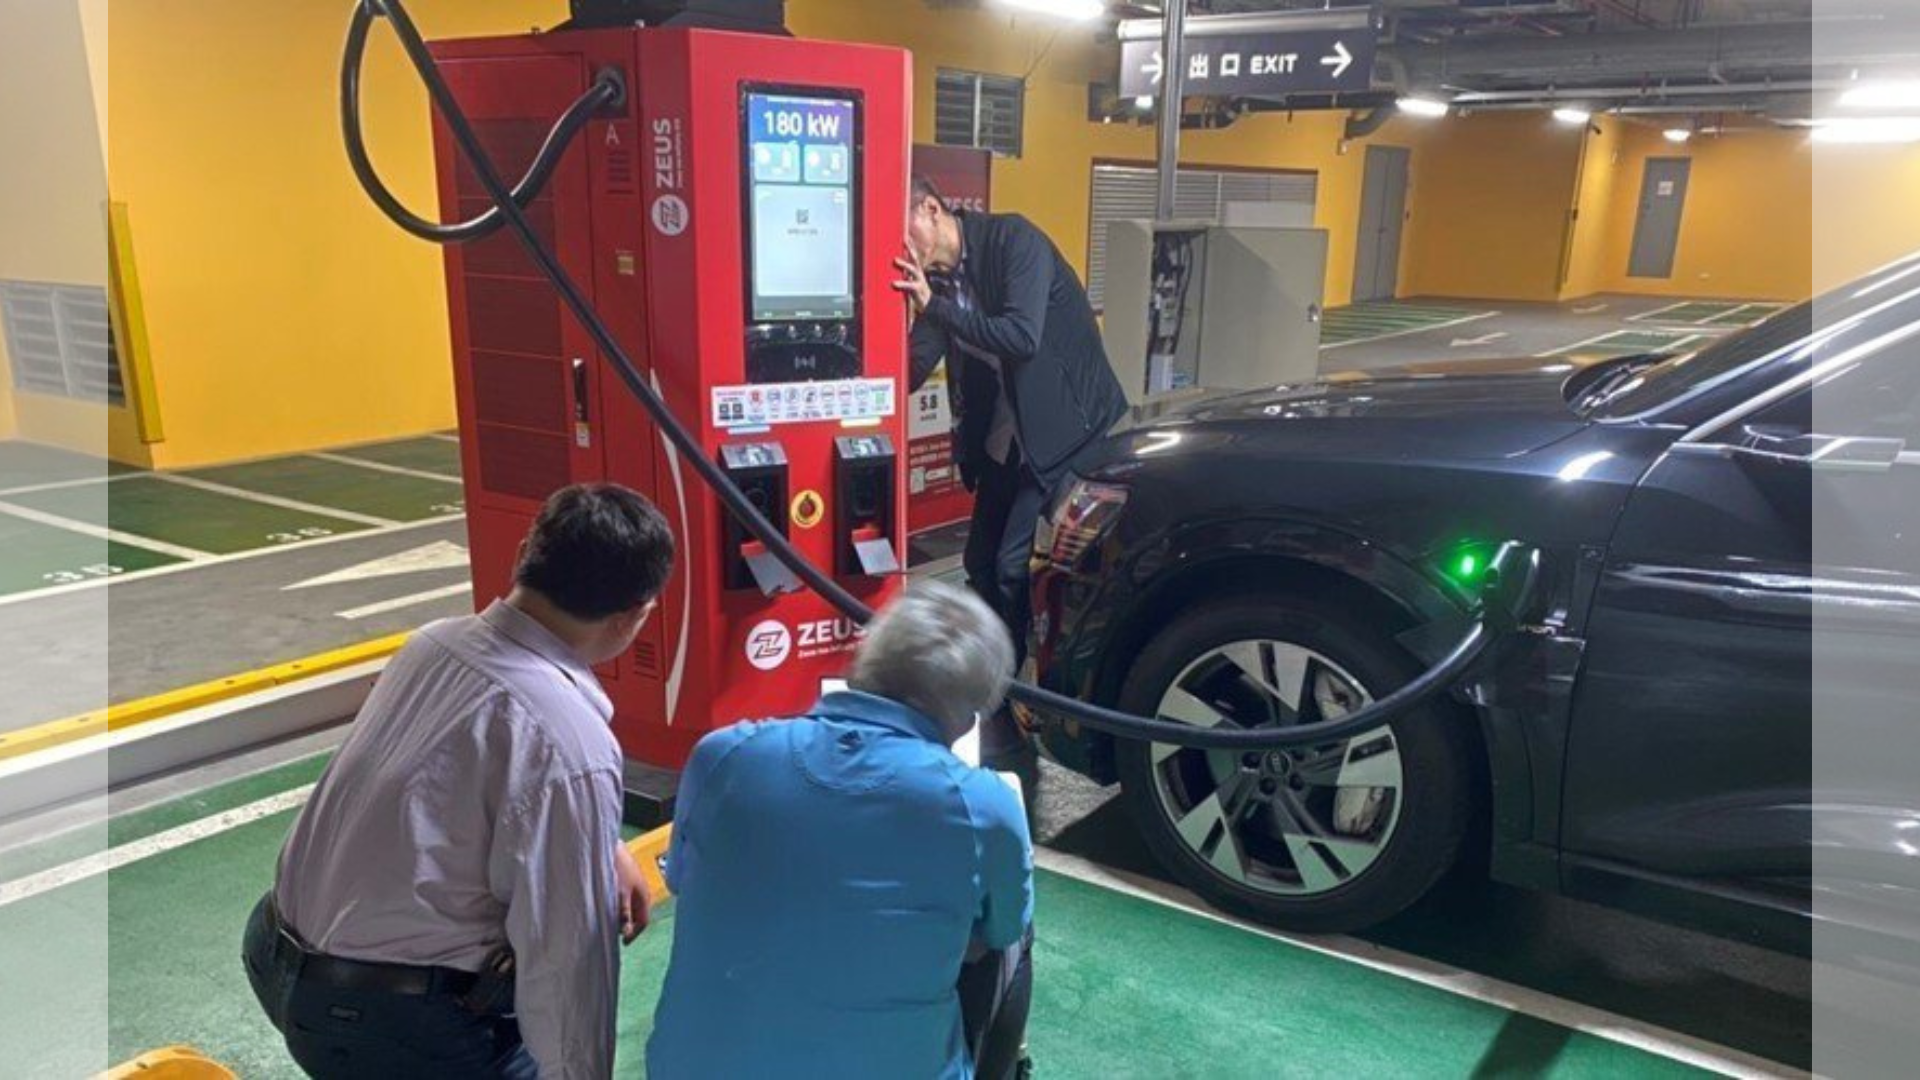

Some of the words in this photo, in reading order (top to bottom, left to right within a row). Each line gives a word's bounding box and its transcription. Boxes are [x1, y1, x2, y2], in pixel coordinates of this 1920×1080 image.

[1189, 53, 1240, 79] 出口
[1250, 53, 1298, 75] EXIT
[605, 122, 620, 145] A
[763, 111, 802, 136] 180
[807, 112, 840, 138] kW
[653, 118, 674, 189] ZEUS
